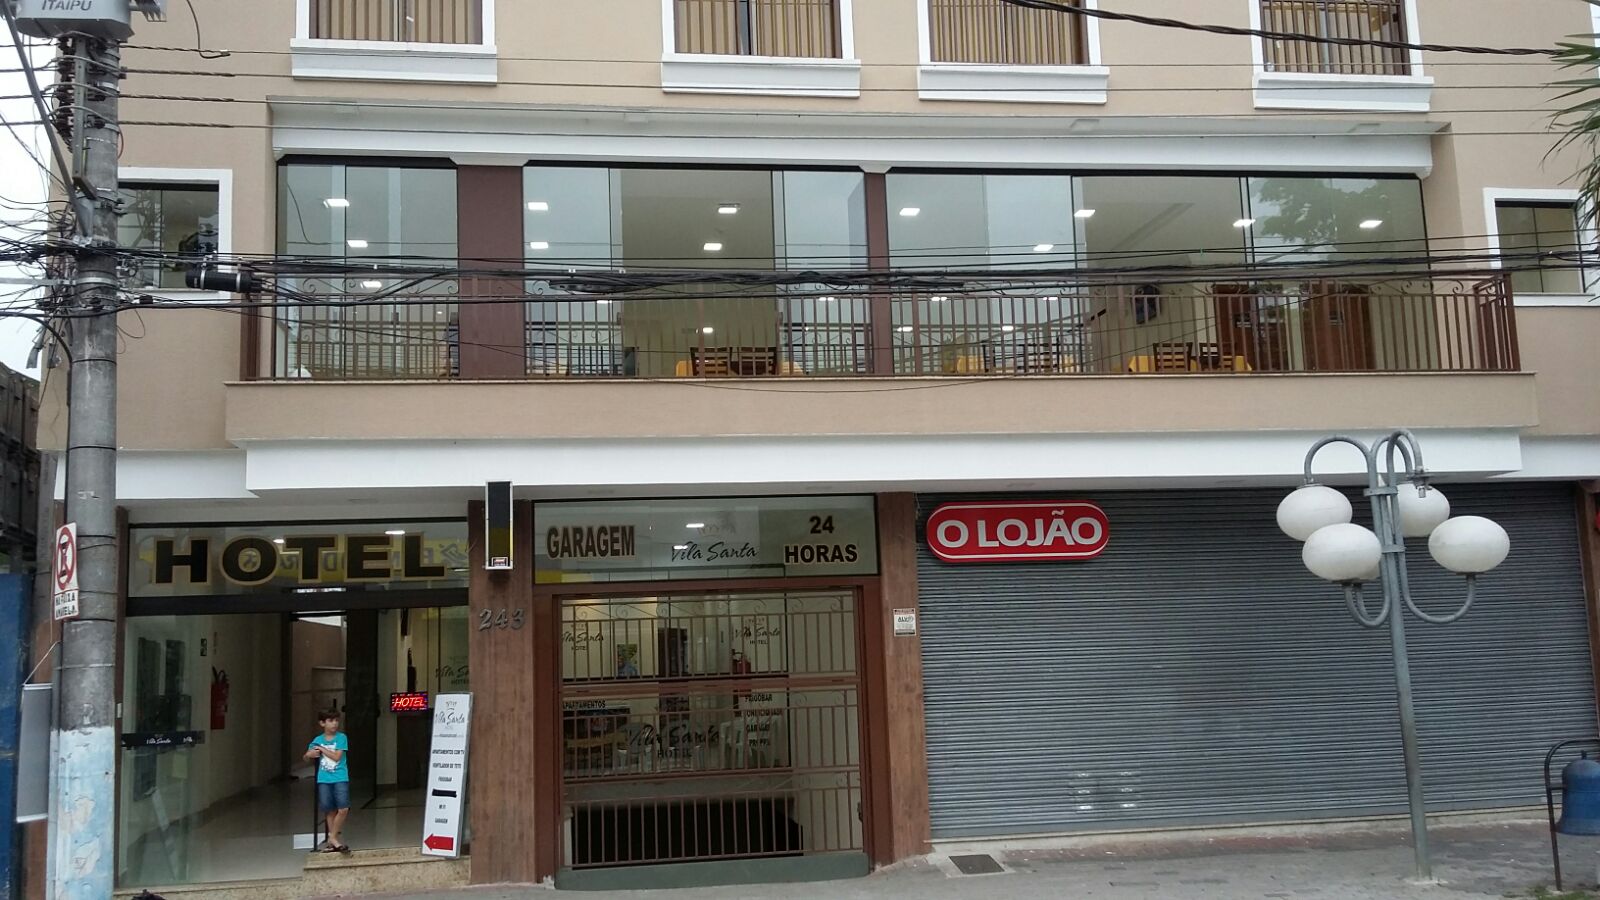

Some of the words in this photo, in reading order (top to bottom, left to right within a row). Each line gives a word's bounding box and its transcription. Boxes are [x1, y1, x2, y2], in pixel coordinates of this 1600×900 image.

[41, 0, 93, 11] ITAIPU
[809, 515, 835, 535] 24
[936, 519, 969, 548] O
[976, 509, 1103, 548] LOJÃO
[546, 524, 636, 559] GARAGEM
[671, 543, 703, 562] Vila
[705, 541, 759, 562] Santa
[152, 531, 449, 587] HOTEL
[783, 543, 859, 564] HORAS
[479, 608, 526, 632] 243
[393, 696, 426, 708] HOTEL
